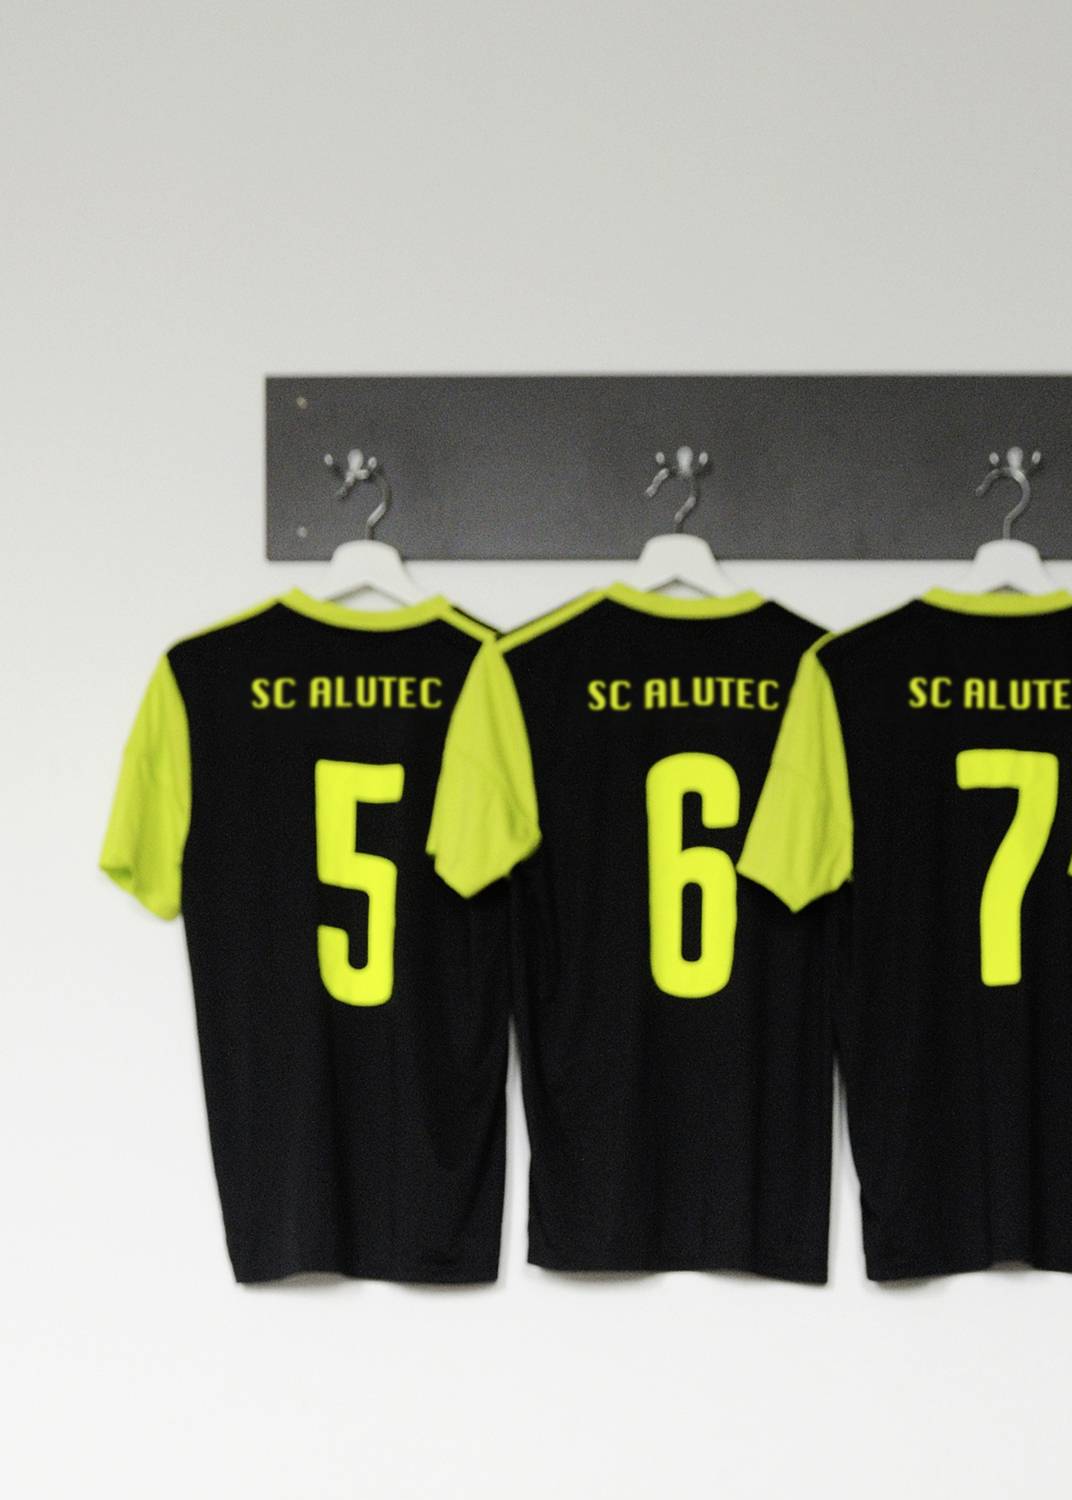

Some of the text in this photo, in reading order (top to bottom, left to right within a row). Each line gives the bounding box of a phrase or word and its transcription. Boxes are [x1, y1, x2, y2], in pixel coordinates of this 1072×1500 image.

[251, 675, 443, 710] SC ALUTEC
[586, 676, 780, 712] SC ALUTEC
[907, 676, 953, 709] SC
[314, 758, 405, 1007] 5
[645, 751, 741, 1000] 6
[955, 748, 1060, 987] 7
